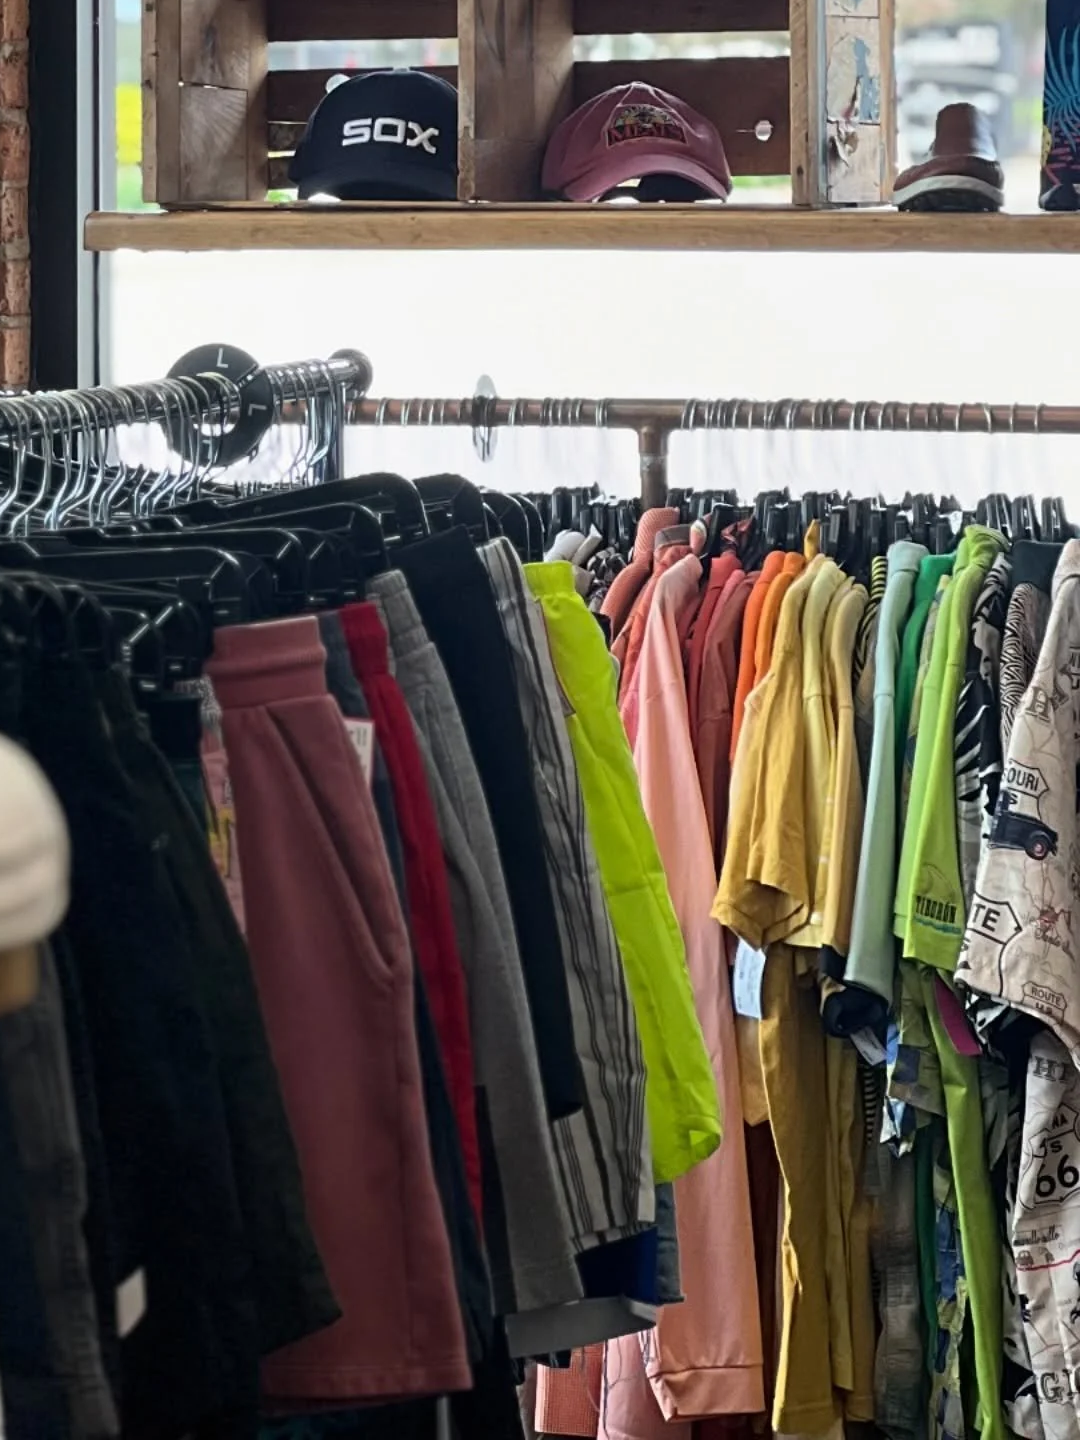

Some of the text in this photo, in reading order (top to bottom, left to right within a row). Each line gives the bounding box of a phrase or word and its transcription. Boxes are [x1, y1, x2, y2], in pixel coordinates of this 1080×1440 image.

[342, 117, 440, 154] SOX
[216, 347, 229, 368] L
[247, 402, 267, 417] L
[1031, 985, 1062, 1007] ROUTE
[1036, 1154, 1080, 1198] 66
